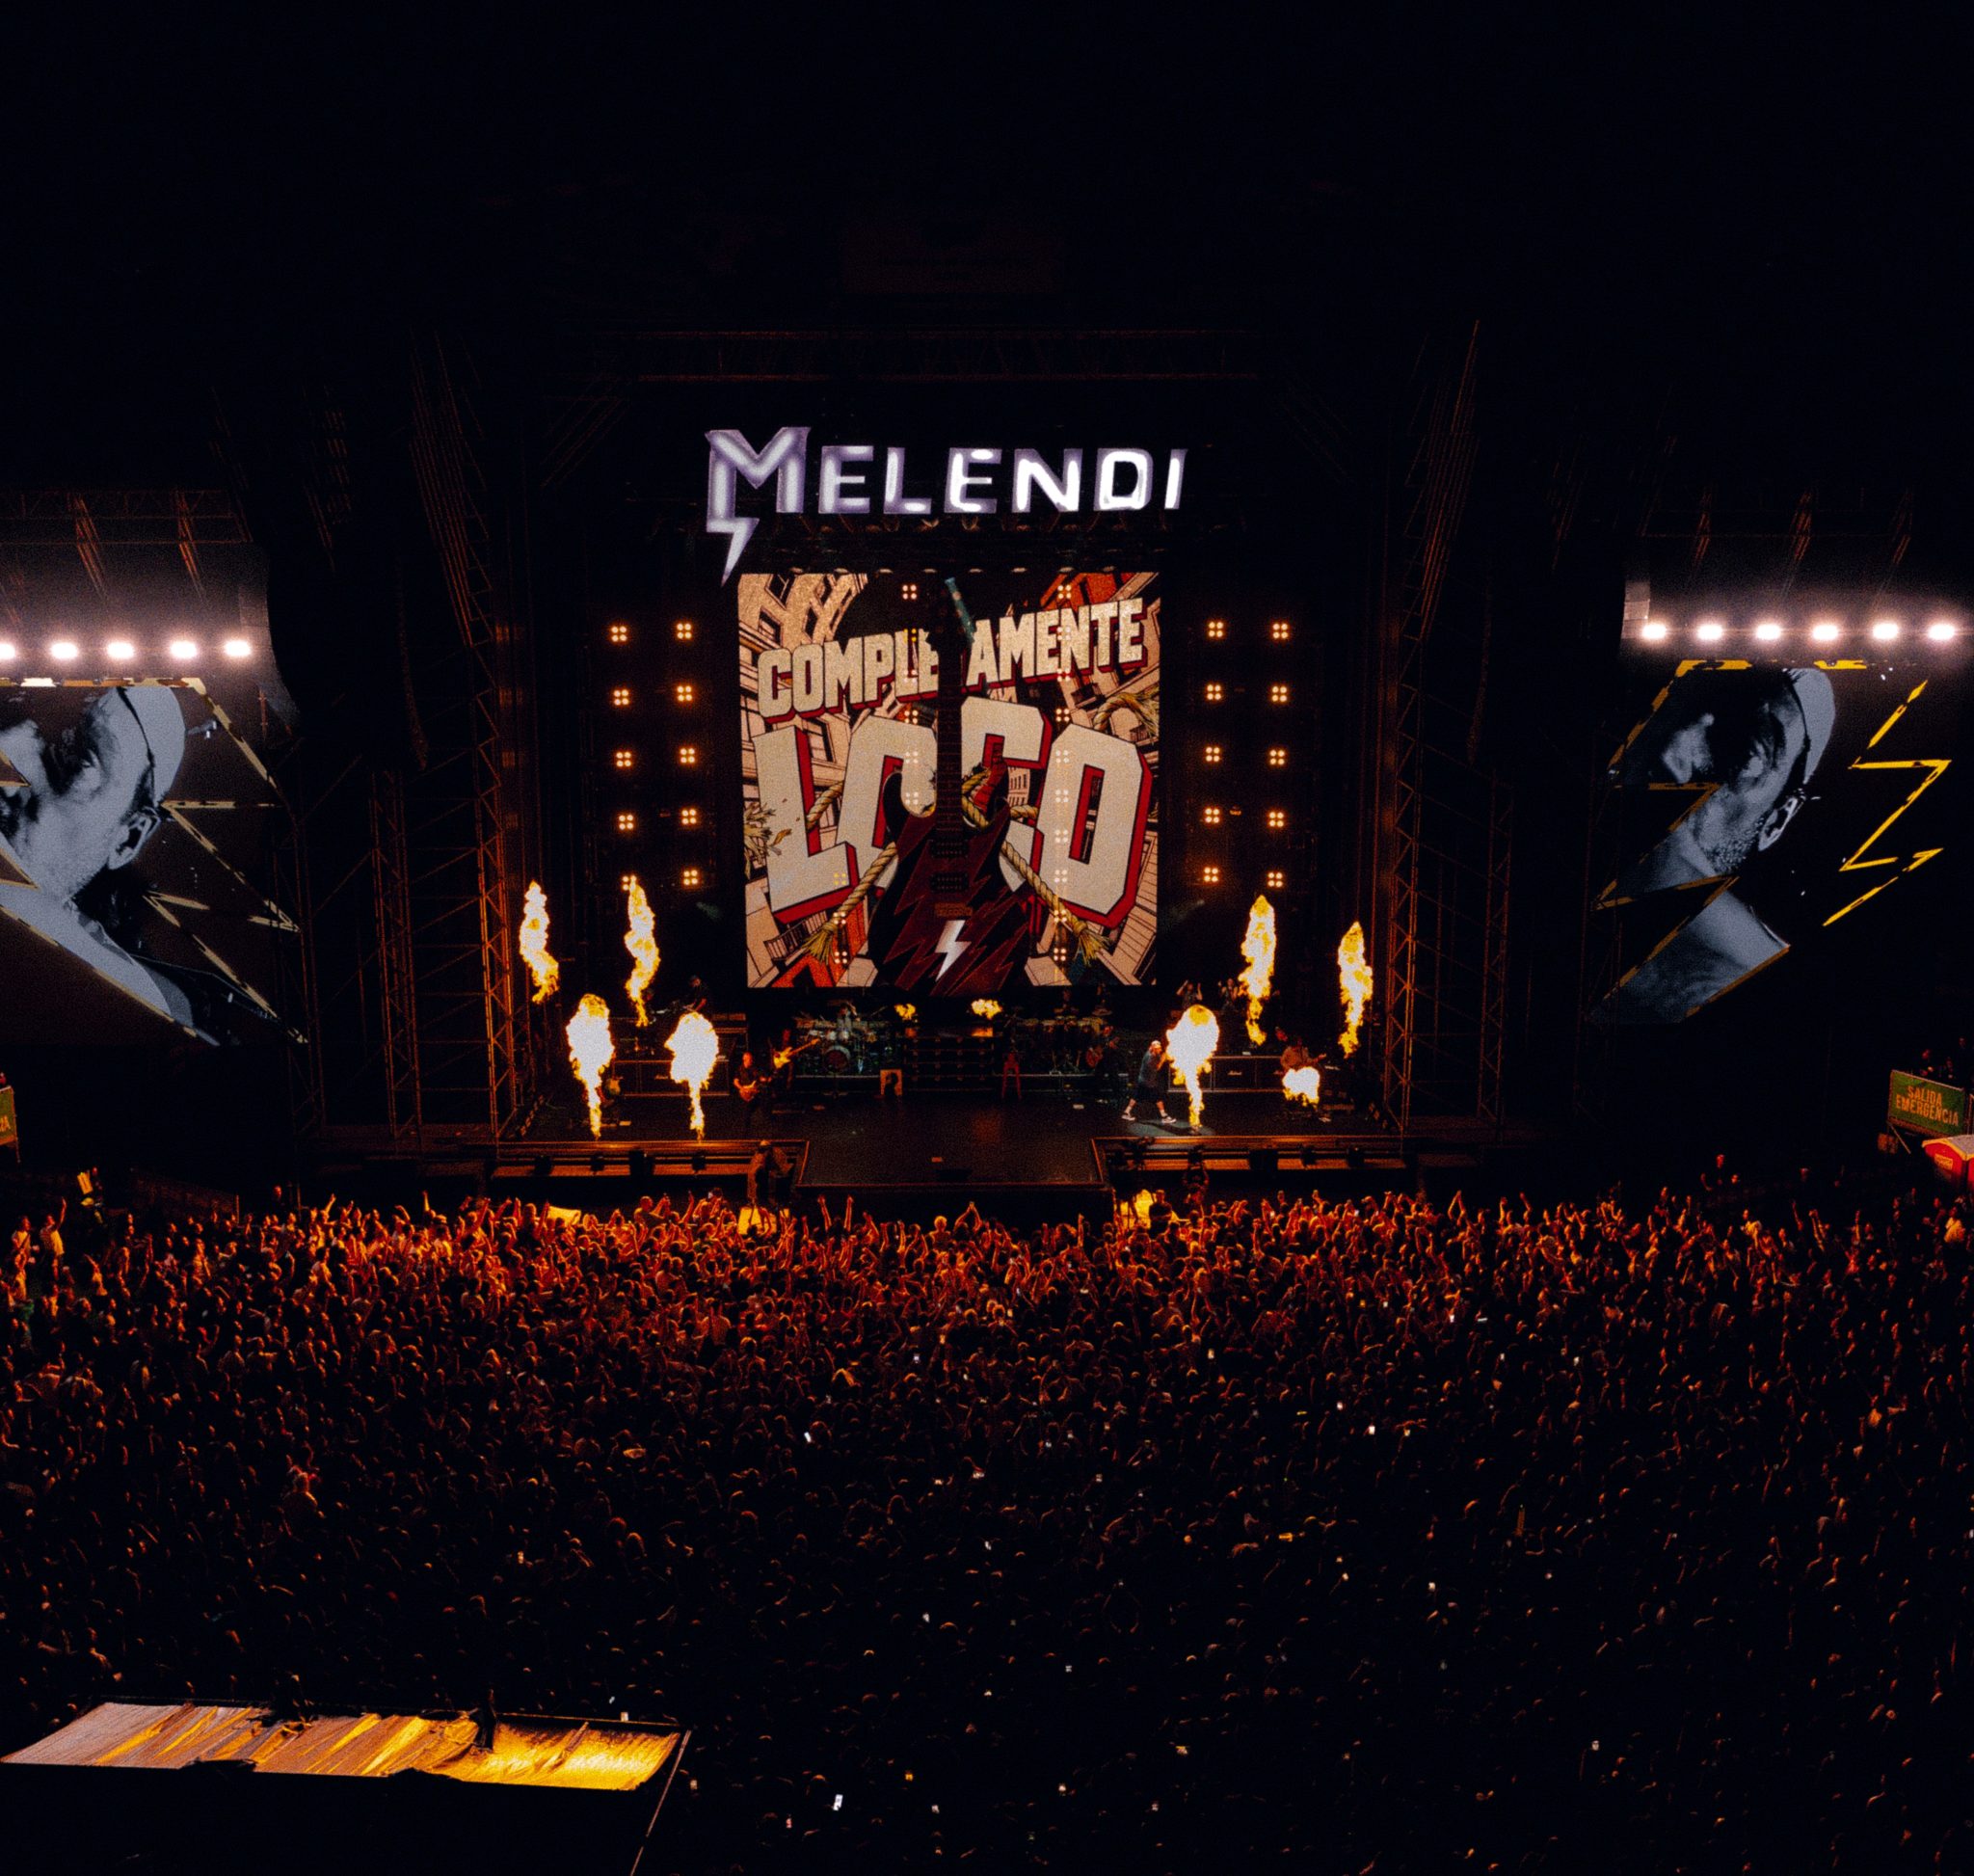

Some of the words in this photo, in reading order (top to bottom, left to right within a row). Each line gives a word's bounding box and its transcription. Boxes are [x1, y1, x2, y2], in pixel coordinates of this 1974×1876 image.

[705, 426, 1188, 587] MELENDI
[758, 598, 1144, 718] COMPLEAMENTE
[1895, 1093, 1960, 1127] EMERGENCIA
[1907, 1085, 1943, 1107] SALIDA
